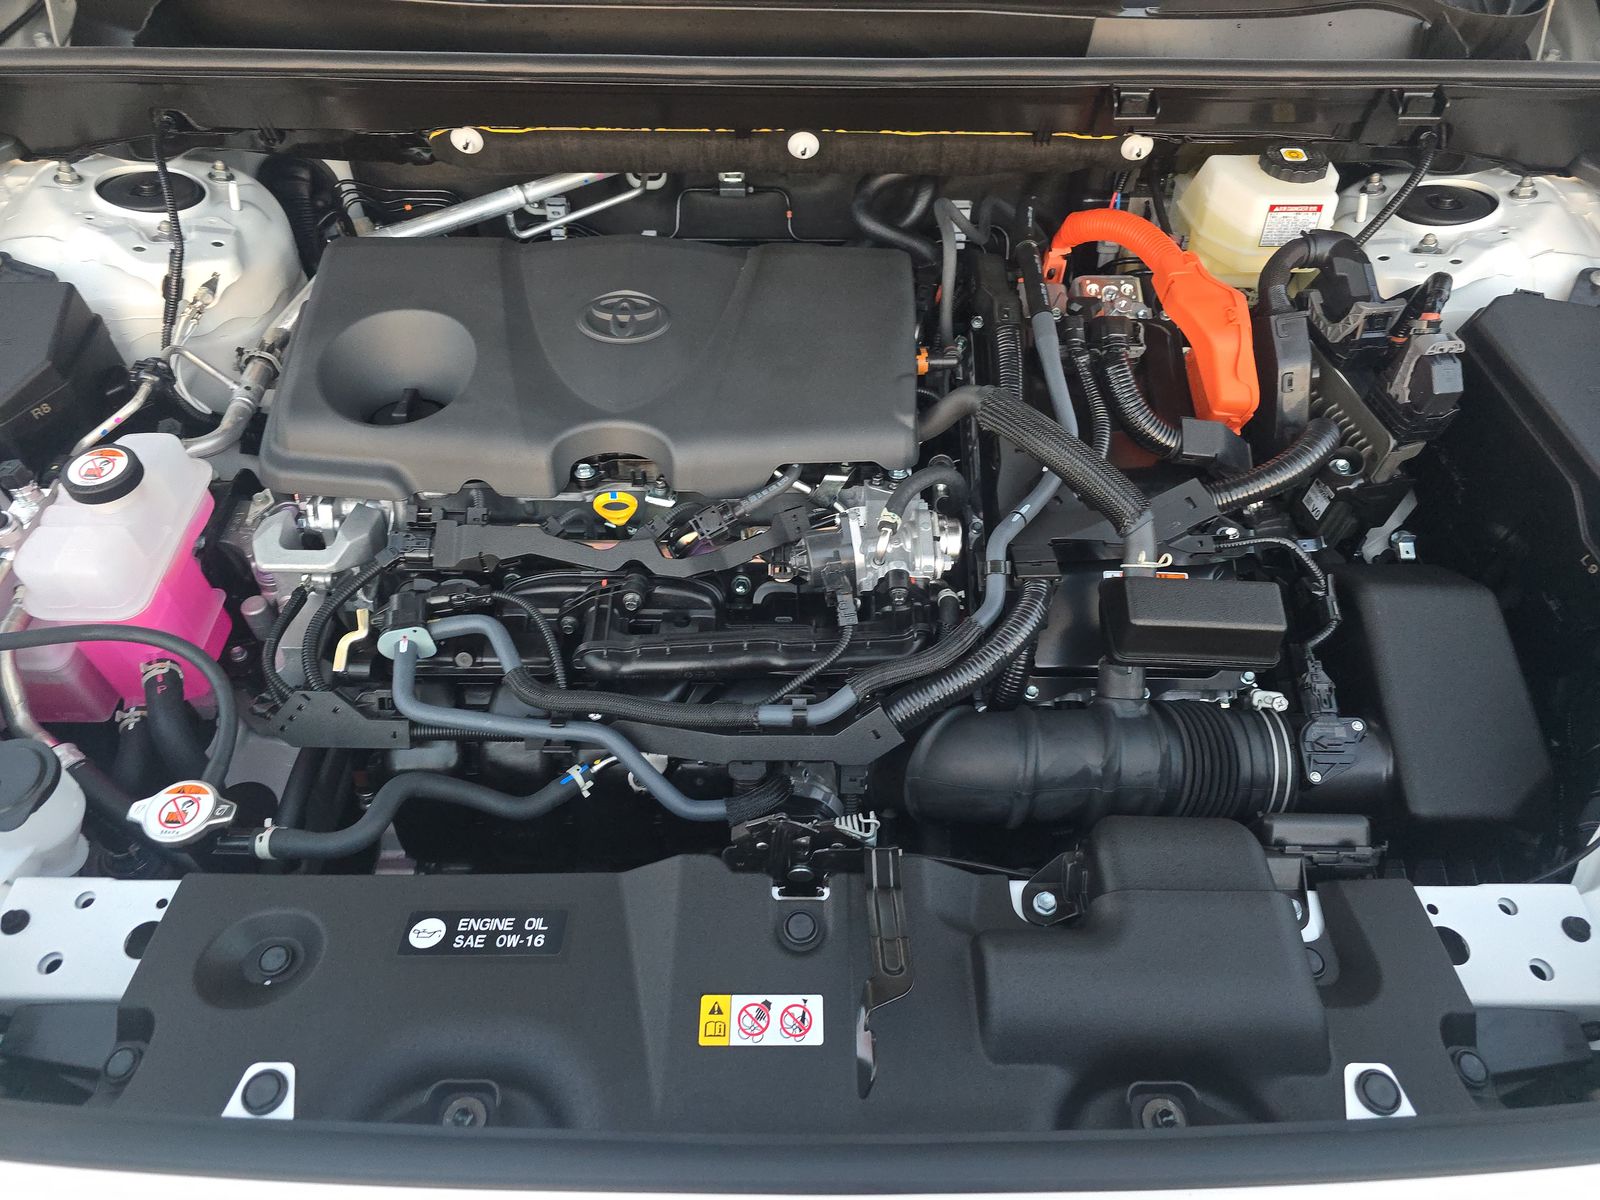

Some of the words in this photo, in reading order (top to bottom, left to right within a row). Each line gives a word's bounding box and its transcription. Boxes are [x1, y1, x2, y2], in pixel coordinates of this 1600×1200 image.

[457, 917, 515, 931] ENGINE
[524, 917, 548, 931] OIL
[453, 934, 487, 948] SAE
[495, 934, 545, 948] 0W-16
